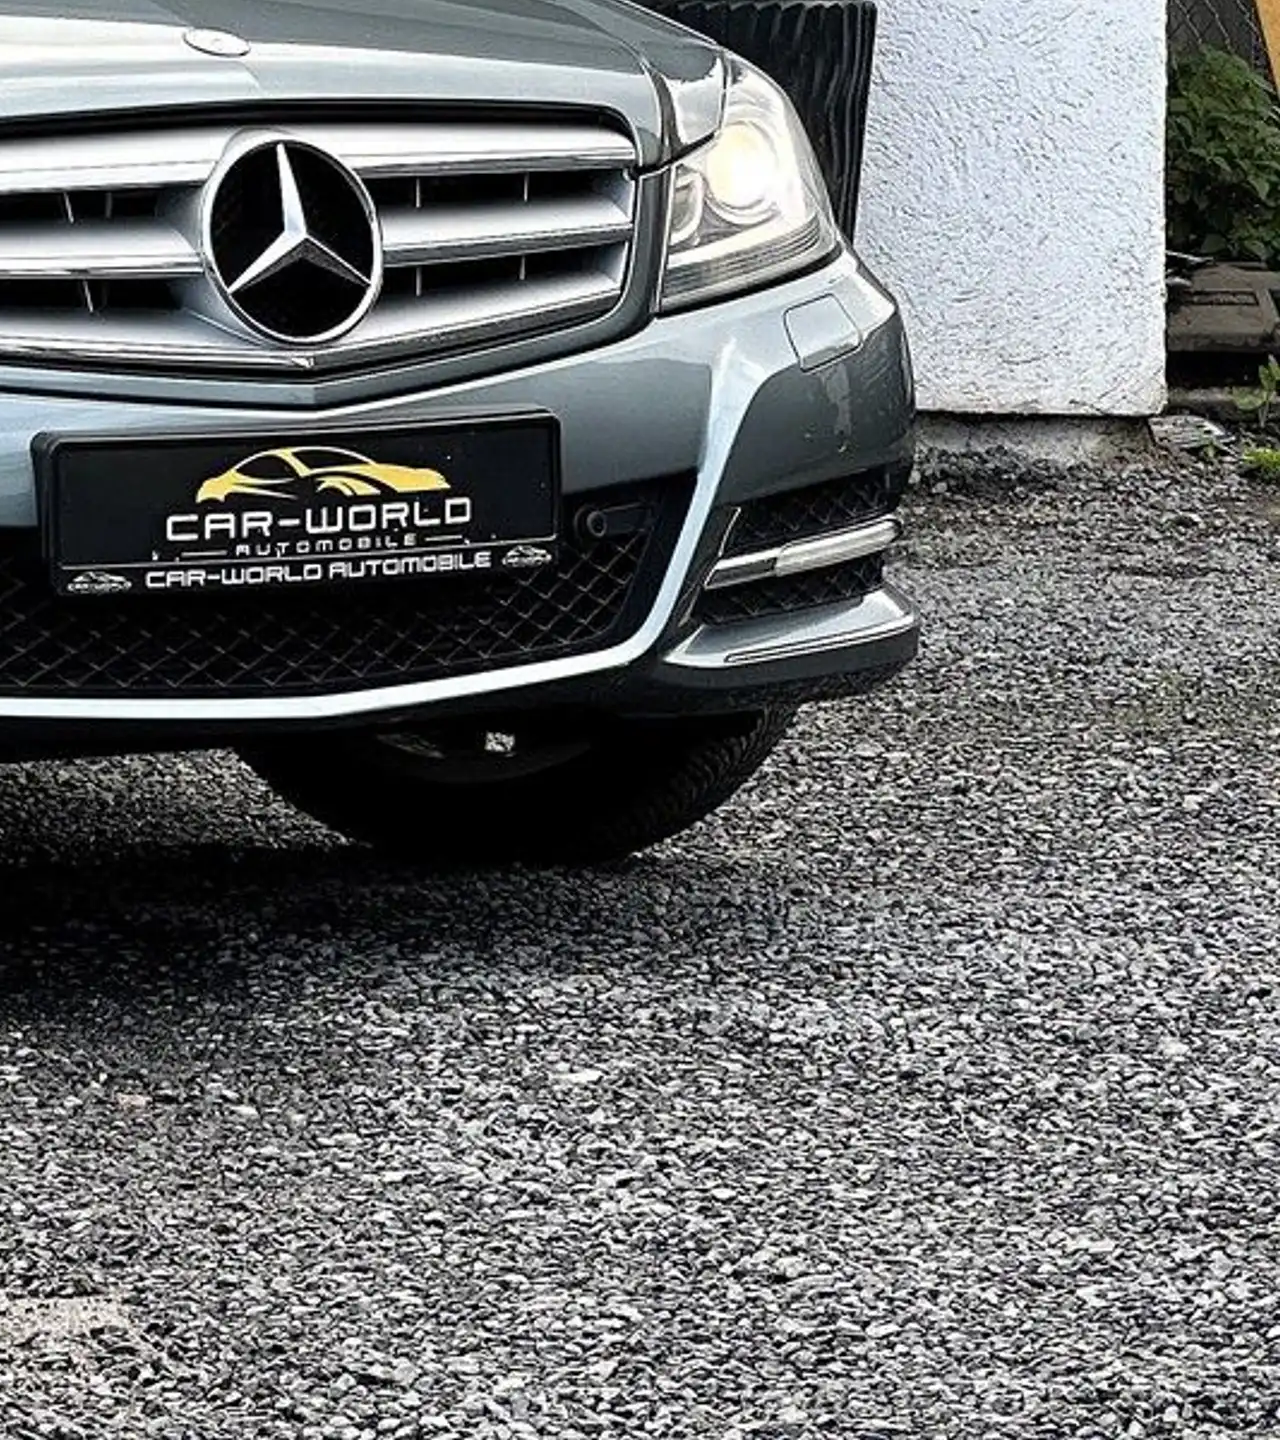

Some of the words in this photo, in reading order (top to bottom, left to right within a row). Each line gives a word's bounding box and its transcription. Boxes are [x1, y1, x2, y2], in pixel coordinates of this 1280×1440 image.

[166, 497, 471, 541] CAR-WORLD
[236, 532, 417, 558] AUTOMOBILE
[145, 563, 322, 588] CAR-WORLD
[329, 551, 491, 580] AUTOMOBILE
